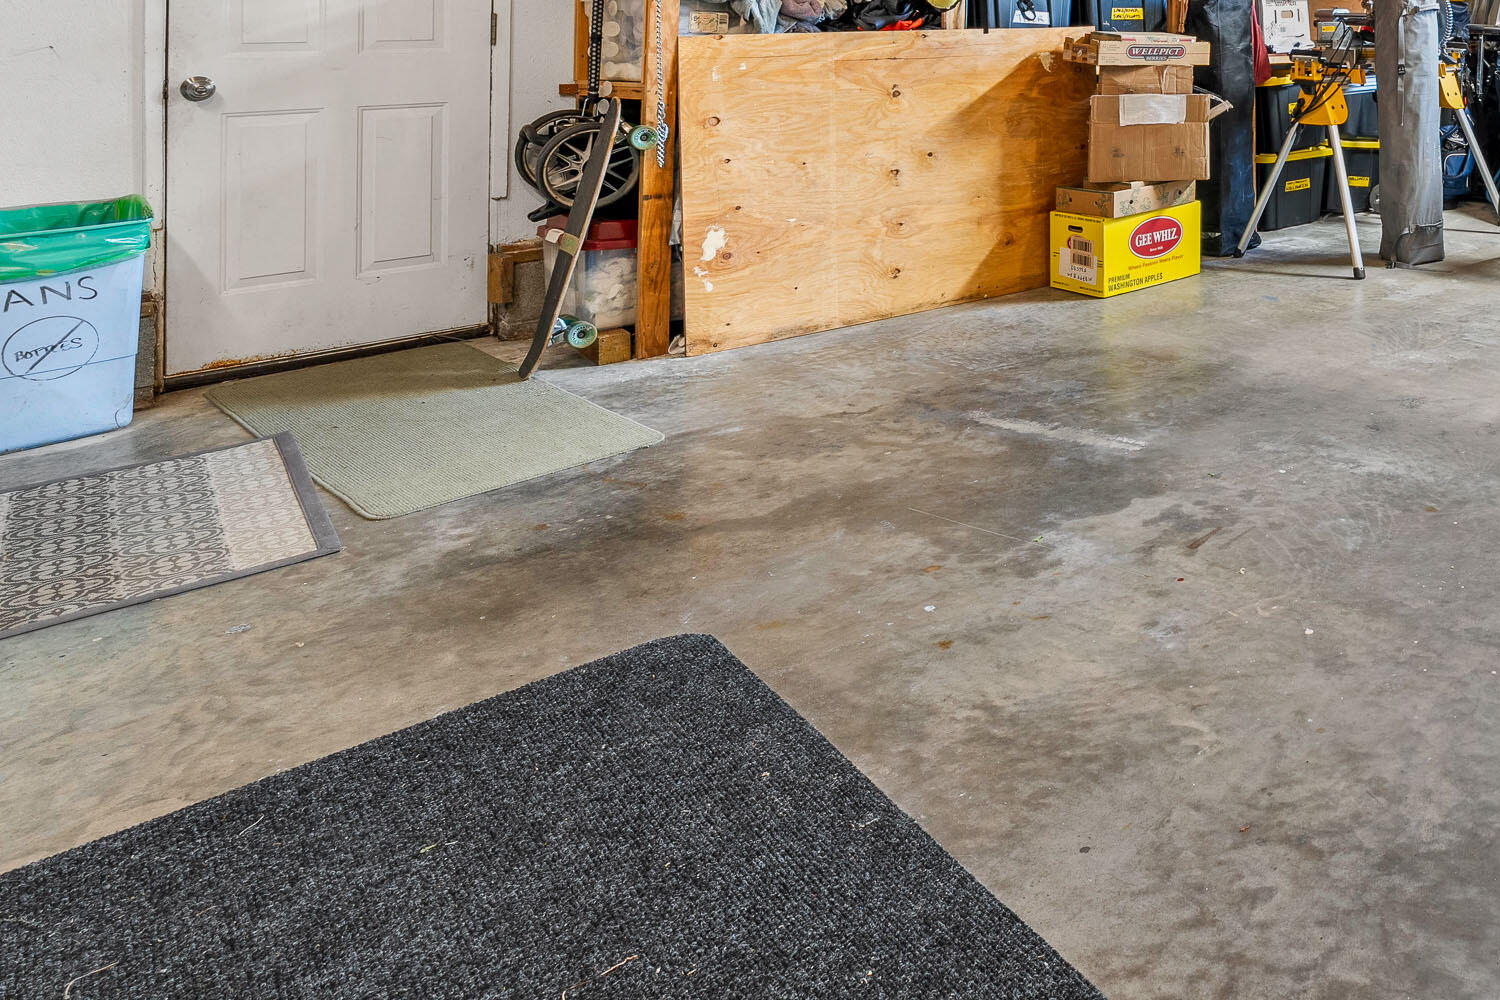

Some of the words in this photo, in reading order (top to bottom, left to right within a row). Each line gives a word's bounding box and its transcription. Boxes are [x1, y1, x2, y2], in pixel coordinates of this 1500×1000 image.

[1135, 233, 1152, 247] GEE
[1153, 228, 1177, 243] WHIZ
[1108, 273, 1131, 283] PREMIUM
[1108, 278, 1144, 292] WASHINGTON
[1144, 272, 1163, 283] APPLES
[3, 276, 98, 312] ANS
